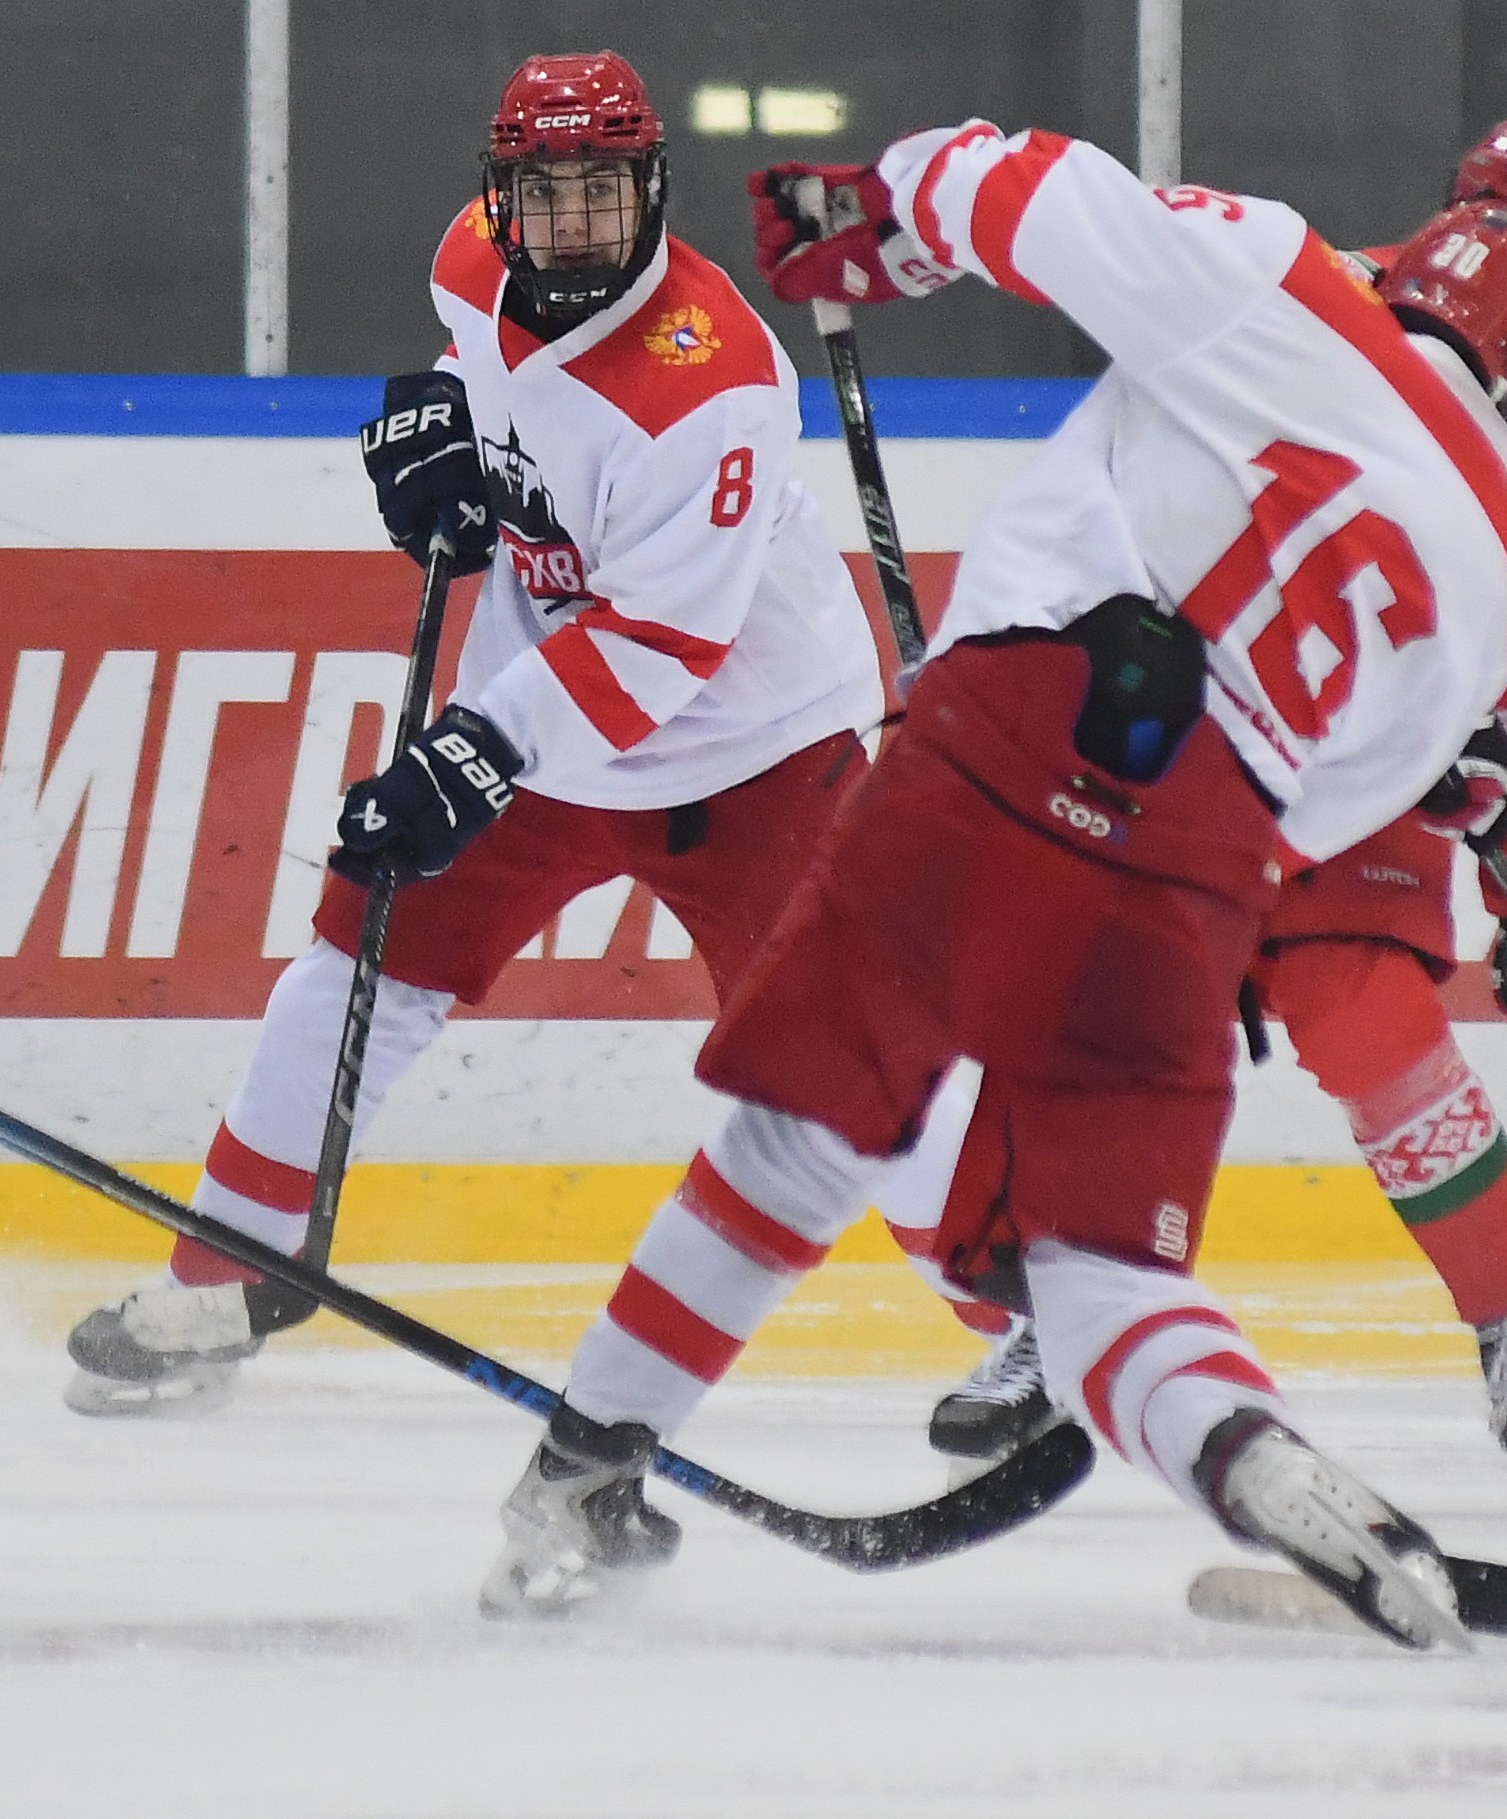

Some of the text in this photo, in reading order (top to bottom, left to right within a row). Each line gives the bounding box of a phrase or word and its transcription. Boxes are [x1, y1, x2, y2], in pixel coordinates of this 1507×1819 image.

[535, 114, 591, 129] CCM
[549, 287, 608, 303] CCM
[709, 446, 754, 527] 8
[1177, 439, 1437, 740] 16
[431, 732, 515, 818] BAU
